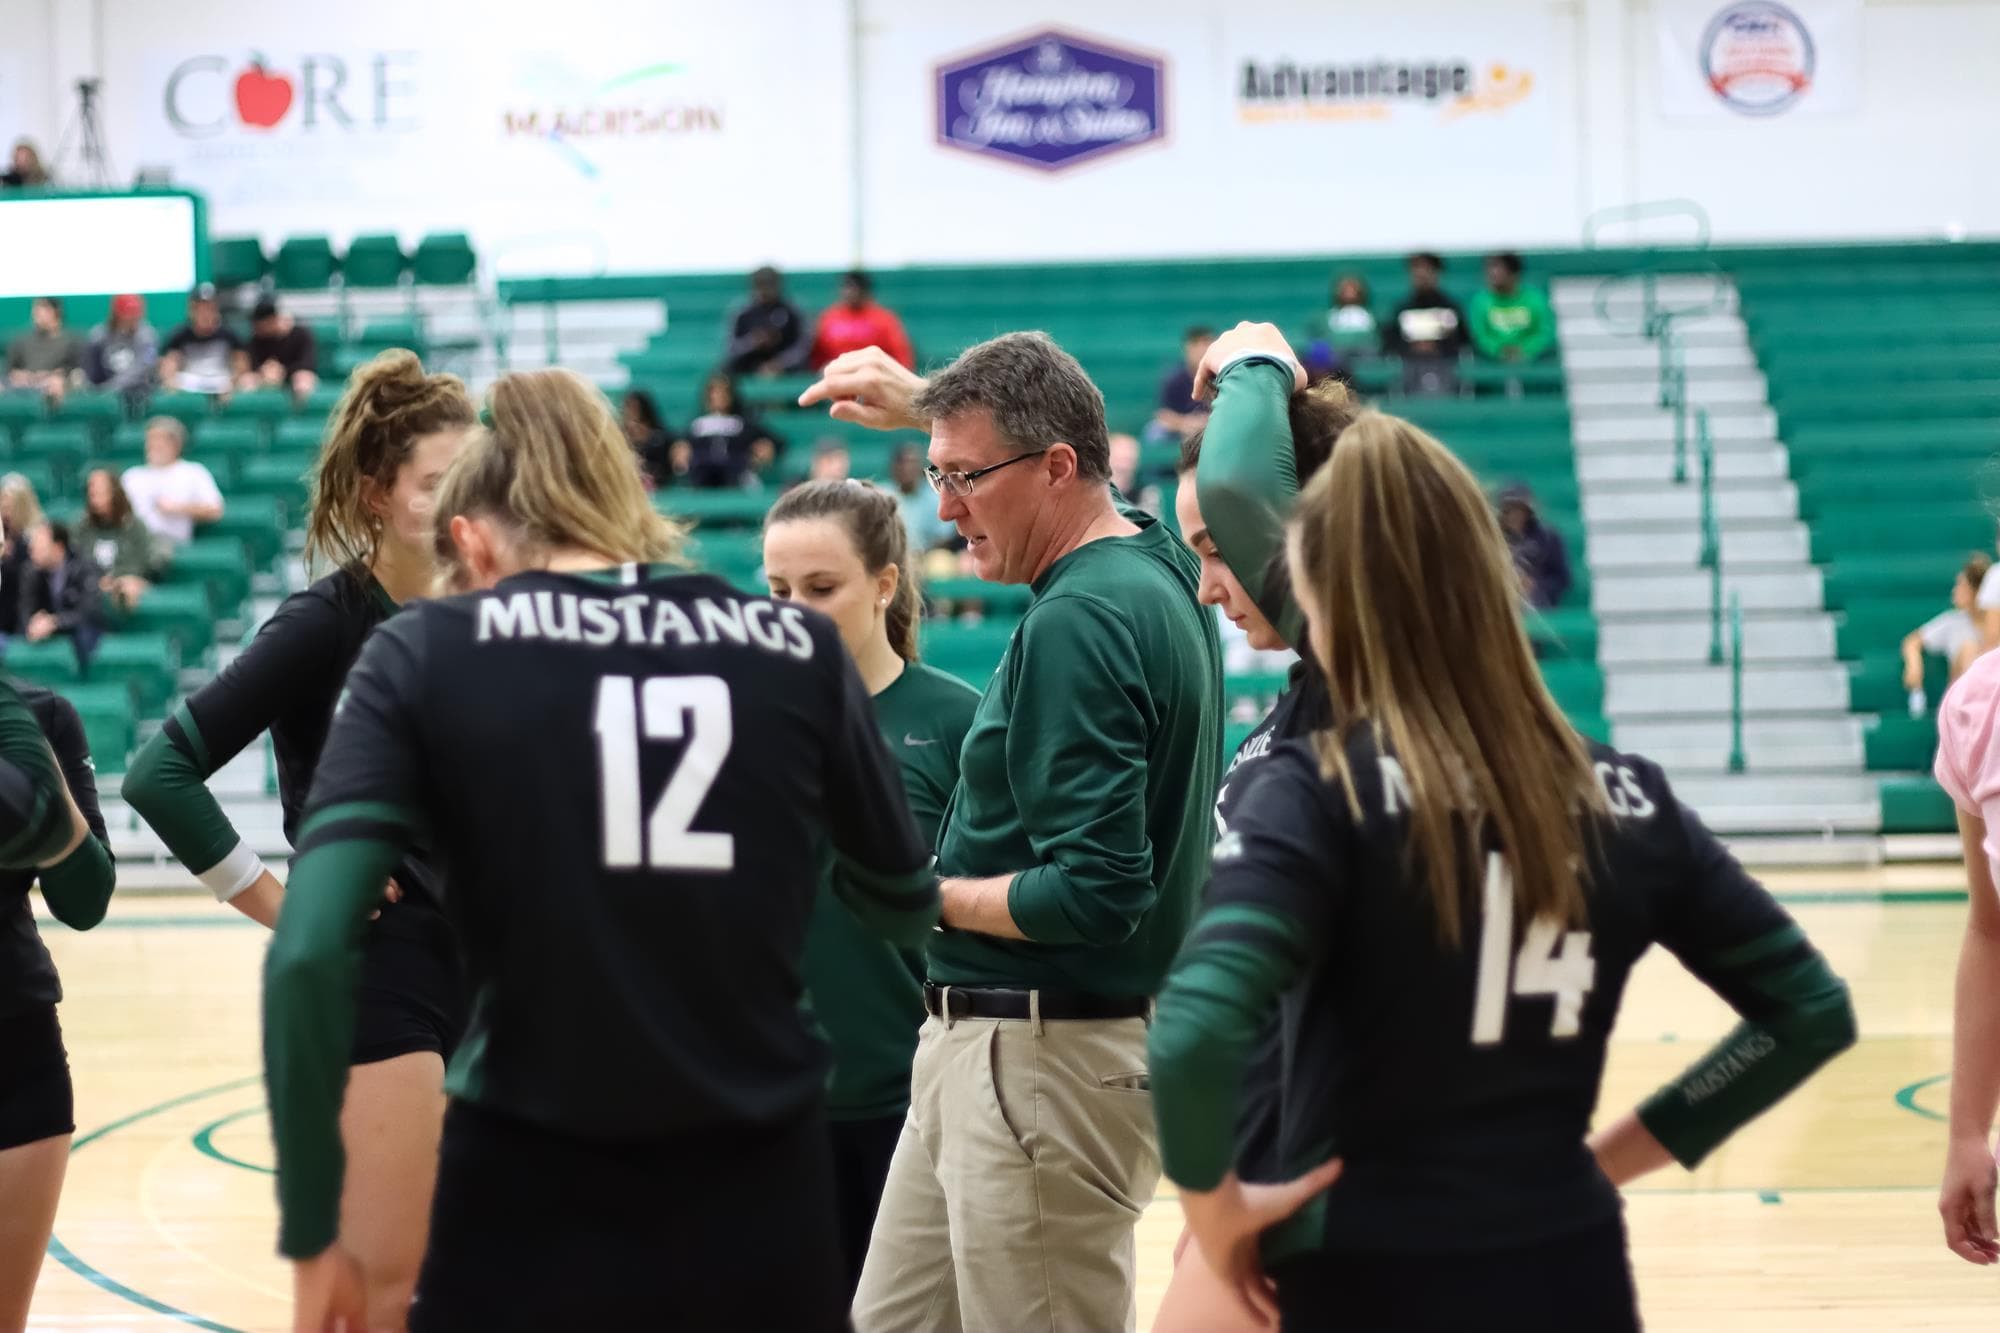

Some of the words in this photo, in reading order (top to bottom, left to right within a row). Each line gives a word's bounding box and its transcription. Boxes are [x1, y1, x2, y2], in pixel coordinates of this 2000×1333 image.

[1240, 59, 1468, 102] Advantage
[477, 591, 814, 660] MUSTANGS
[595, 675, 735, 871] 12
[1472, 851, 1596, 1045] 14
[1683, 1032, 1777, 1105] MUSTANGS
